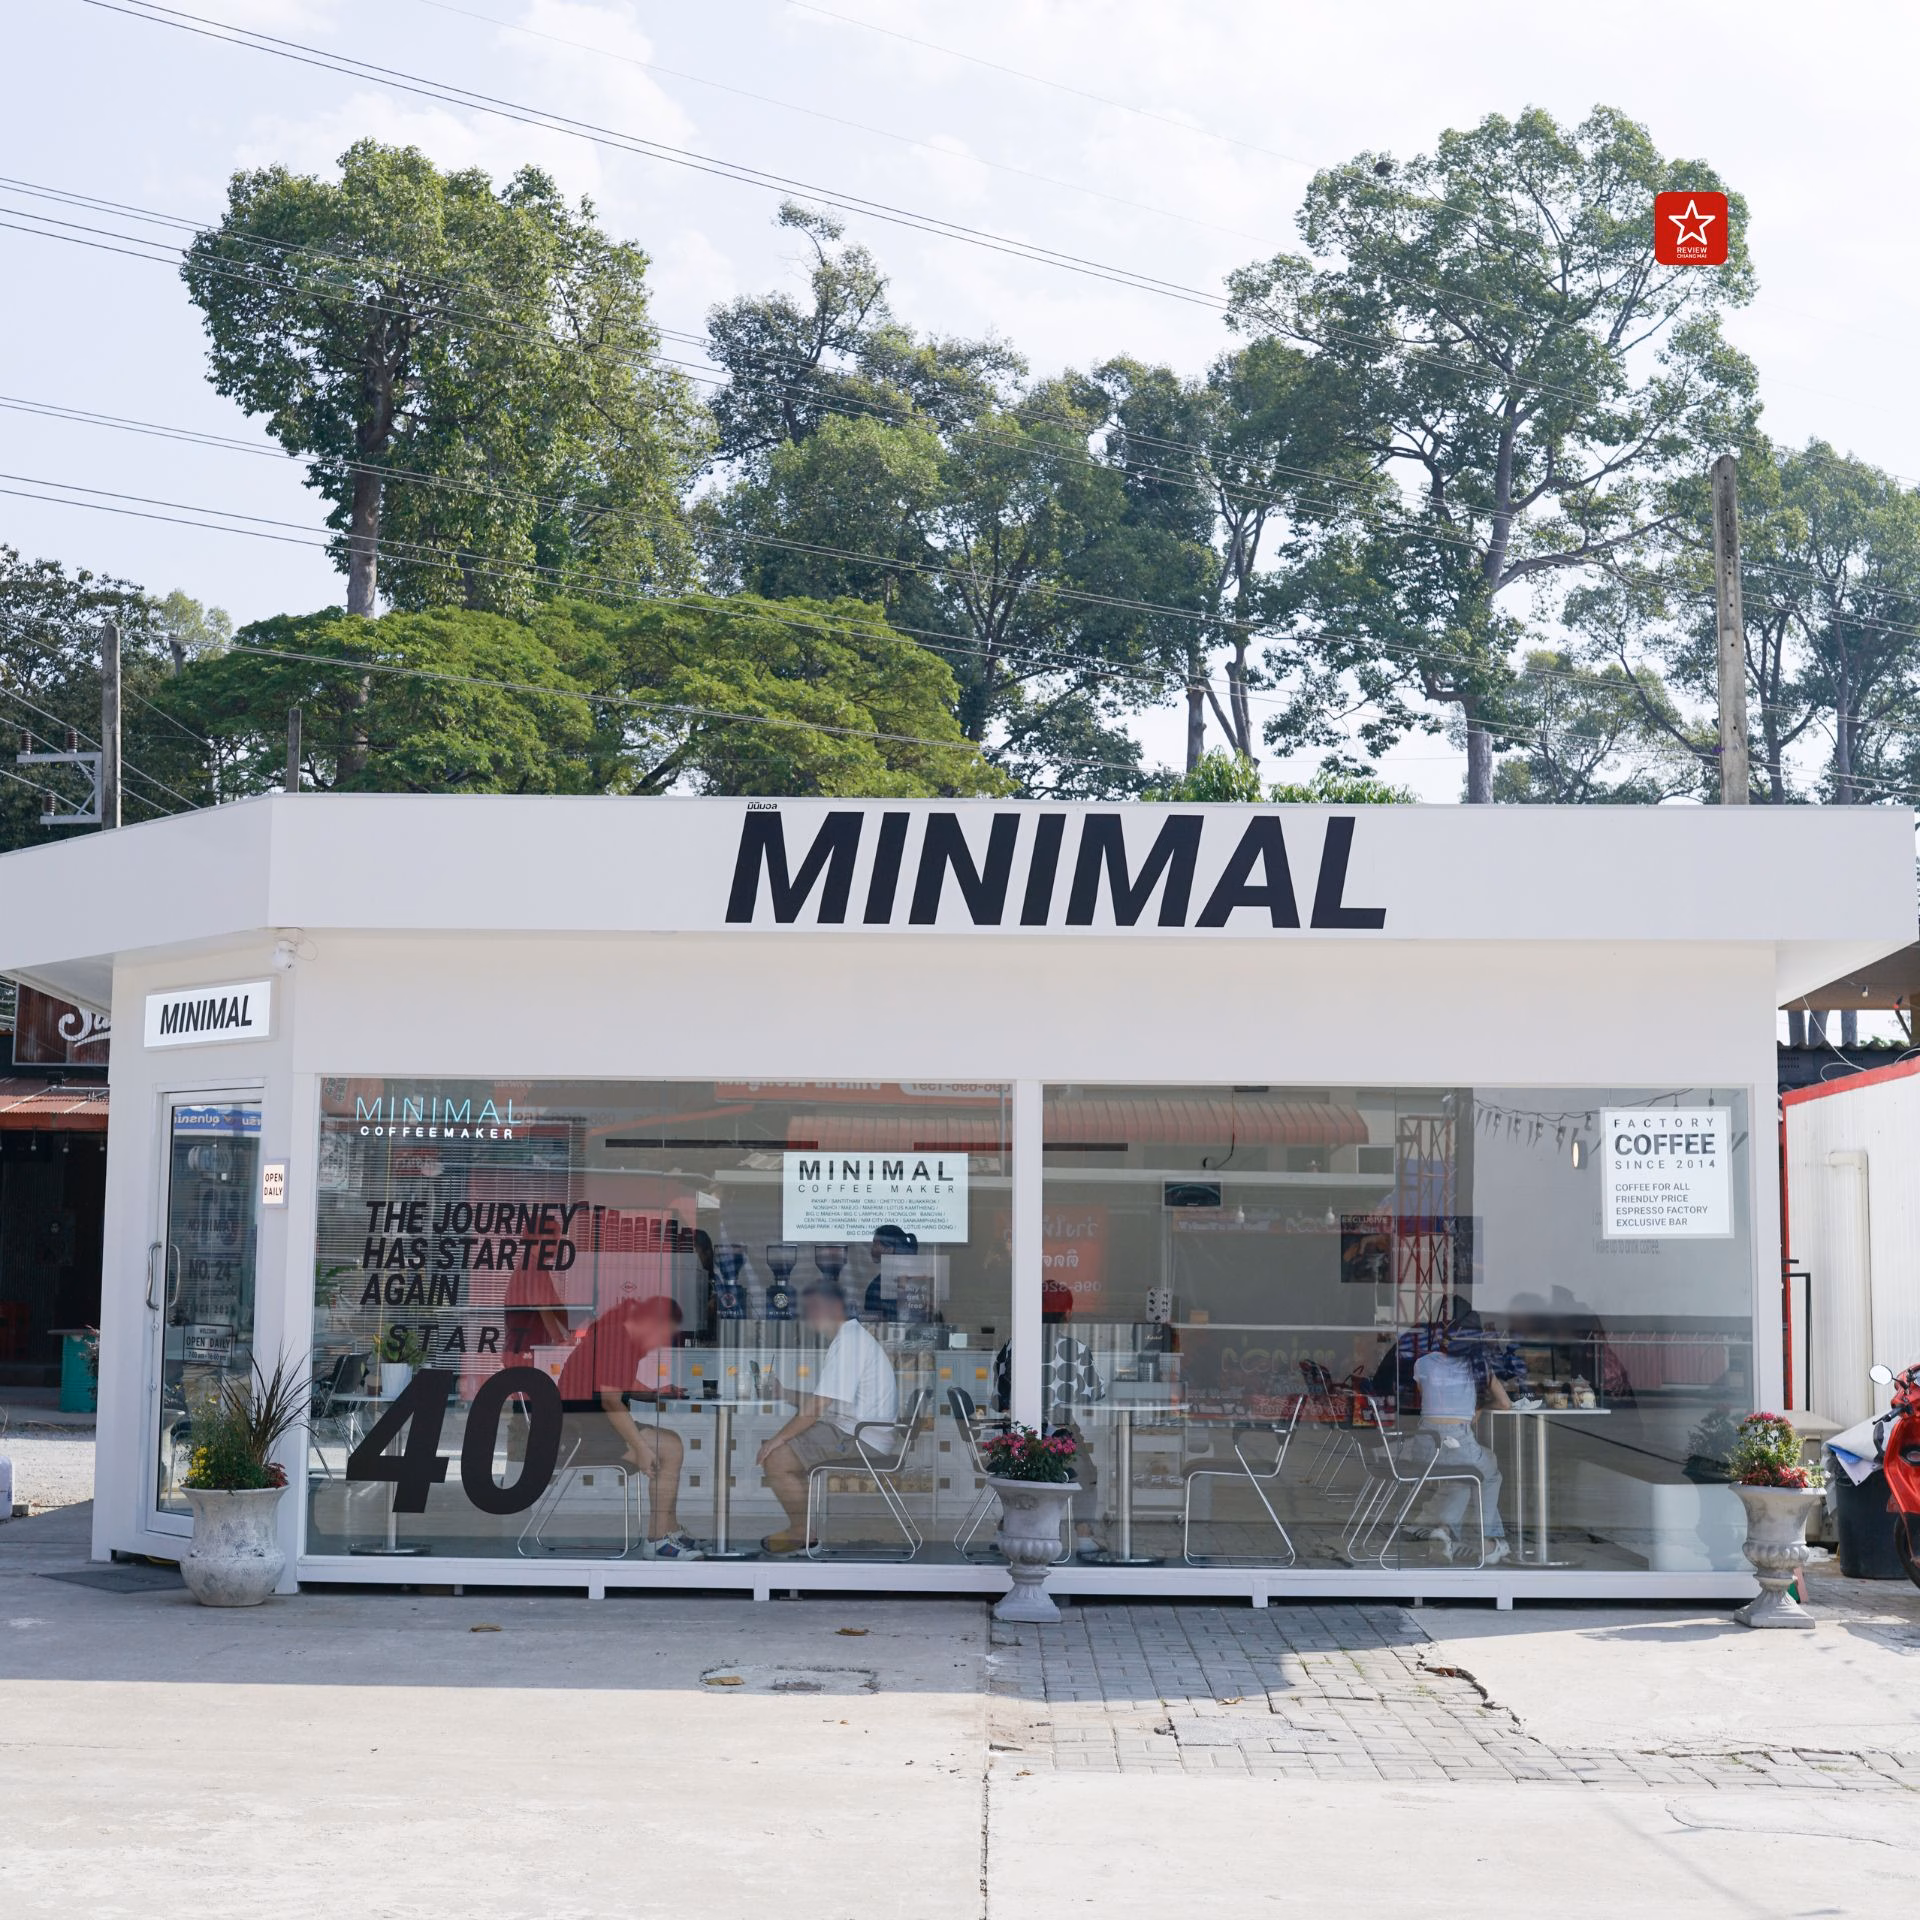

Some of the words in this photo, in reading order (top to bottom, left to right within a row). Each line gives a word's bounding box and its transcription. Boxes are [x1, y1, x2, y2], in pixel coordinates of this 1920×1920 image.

[725, 811, 1387, 929] MINIMAL
[160, 995, 252, 1035] MINIMAL
[356, 1096, 522, 1125] MINIMAL
[1614, 1118, 1714, 1128] FACTORY
[360, 1126, 513, 1140] COFFEEMAKER
[1614, 1133, 1716, 1156] COFFEE
[799, 1160, 954, 1182] MINIMAL
[1615, 1160, 1665, 1170] SINCE
[1676, 1159, 1715, 1169] 2014
[264, 1173, 283, 1182] OPEN
[263, 1187, 283, 1196] DAILY
[798, 1184, 873, 1193] COFFEE
[890, 1185, 954, 1194] MAKER
[1615, 1183, 1650, 1192] COFFEE
[1652, 1183, 1671, 1191] FOR
[1673, 1183, 1690, 1191] ALL
[1615, 1195, 1659, 1203] FRIENDLY
[1661, 1194, 1689, 1203] PRICE
[1616, 1206, 1664, 1215] ESPRESSO
[1666, 1205, 1708, 1214] FACTORY
[366, 1201, 428, 1234] THE
[433, 1202, 580, 1235] JOURNEY
[1616, 1218, 1667, 1227] EXCLUSIVE
[1668, 1217, 1688, 1226] BAR
[362, 1237, 429, 1270] HAS
[437, 1238, 577, 1272] STARTED
[360, 1273, 461, 1306] AGAIN
[186, 1336, 206, 1347] OPEN
[209, 1337, 231, 1349] DAILY
[387, 1324, 531, 1354] START
[346, 1366, 563, 1515] 40
